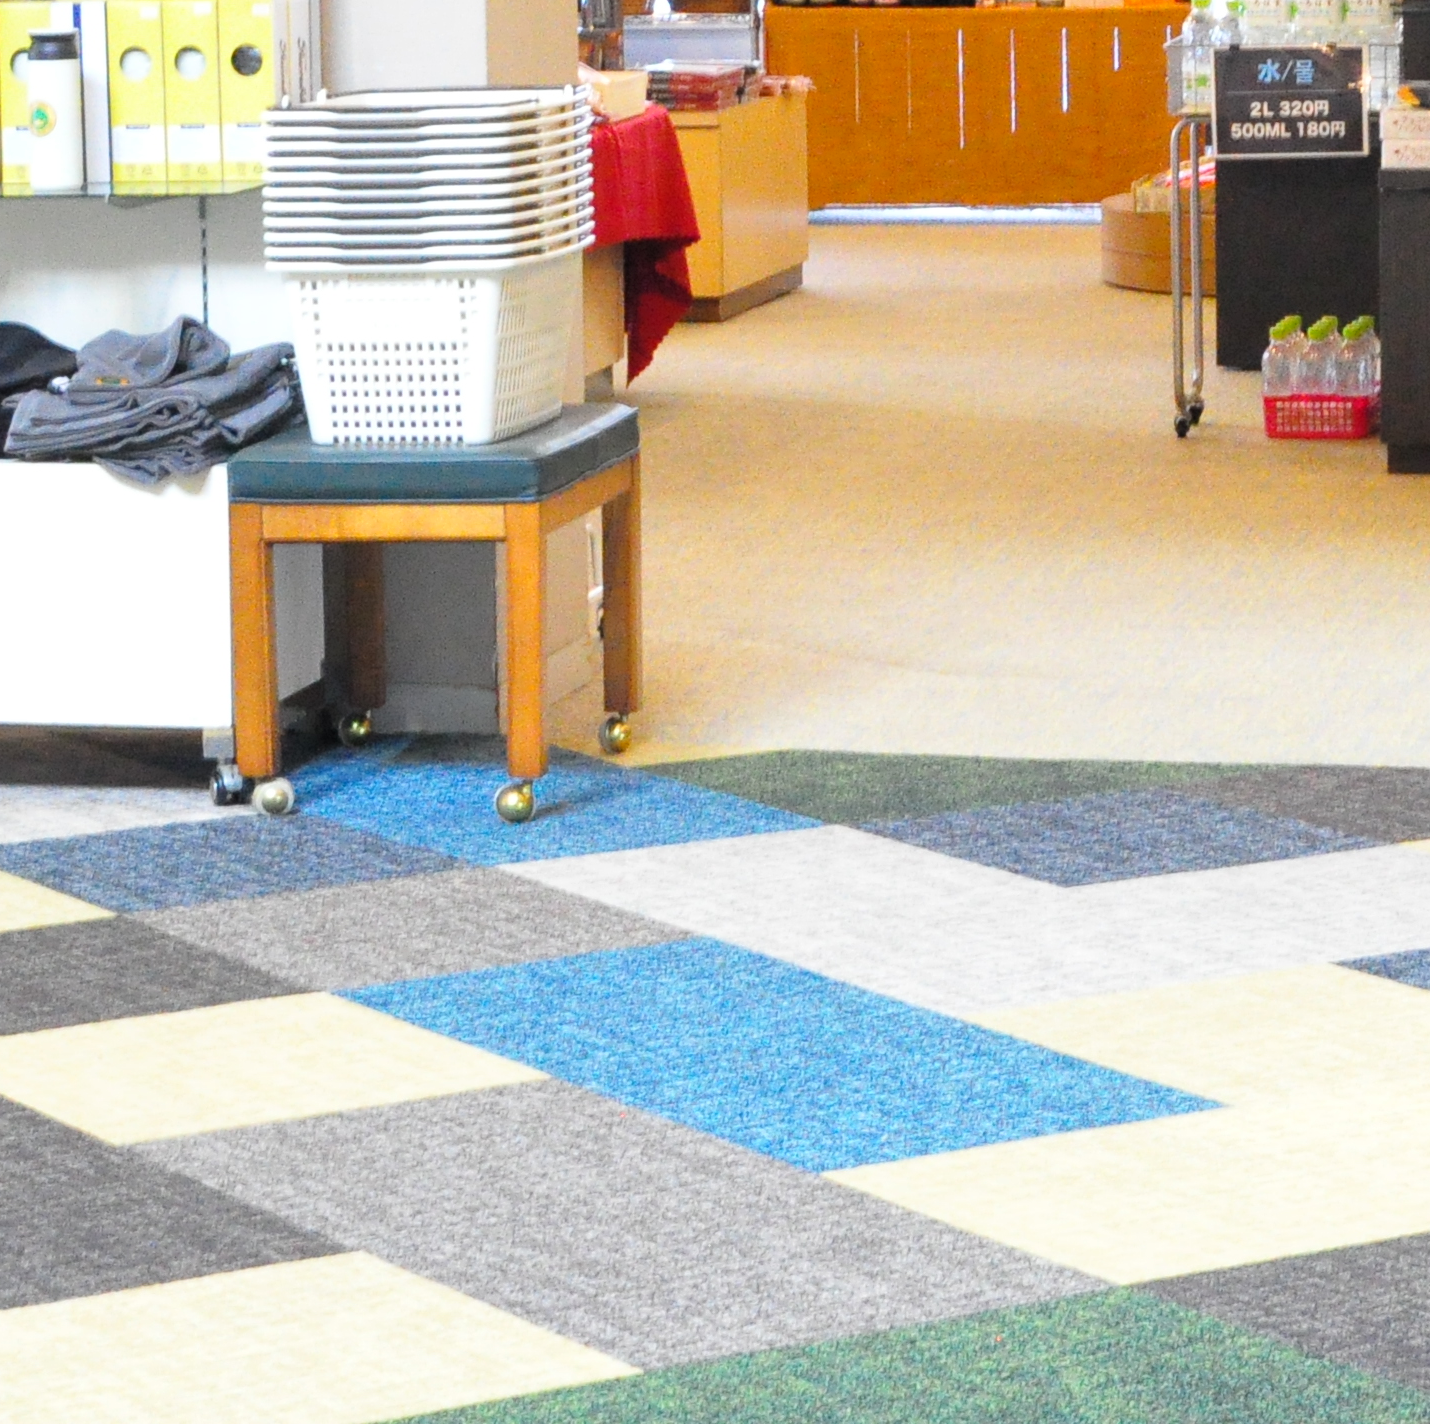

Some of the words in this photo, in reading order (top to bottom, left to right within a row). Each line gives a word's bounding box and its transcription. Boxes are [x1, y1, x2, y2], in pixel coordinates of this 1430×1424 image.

[1249, 100, 1275, 118] 2L
[1279, 99, 1330, 118] 320円
[1231, 122, 1292, 140] 500ML
[1297, 121, 1347, 139] 180円
